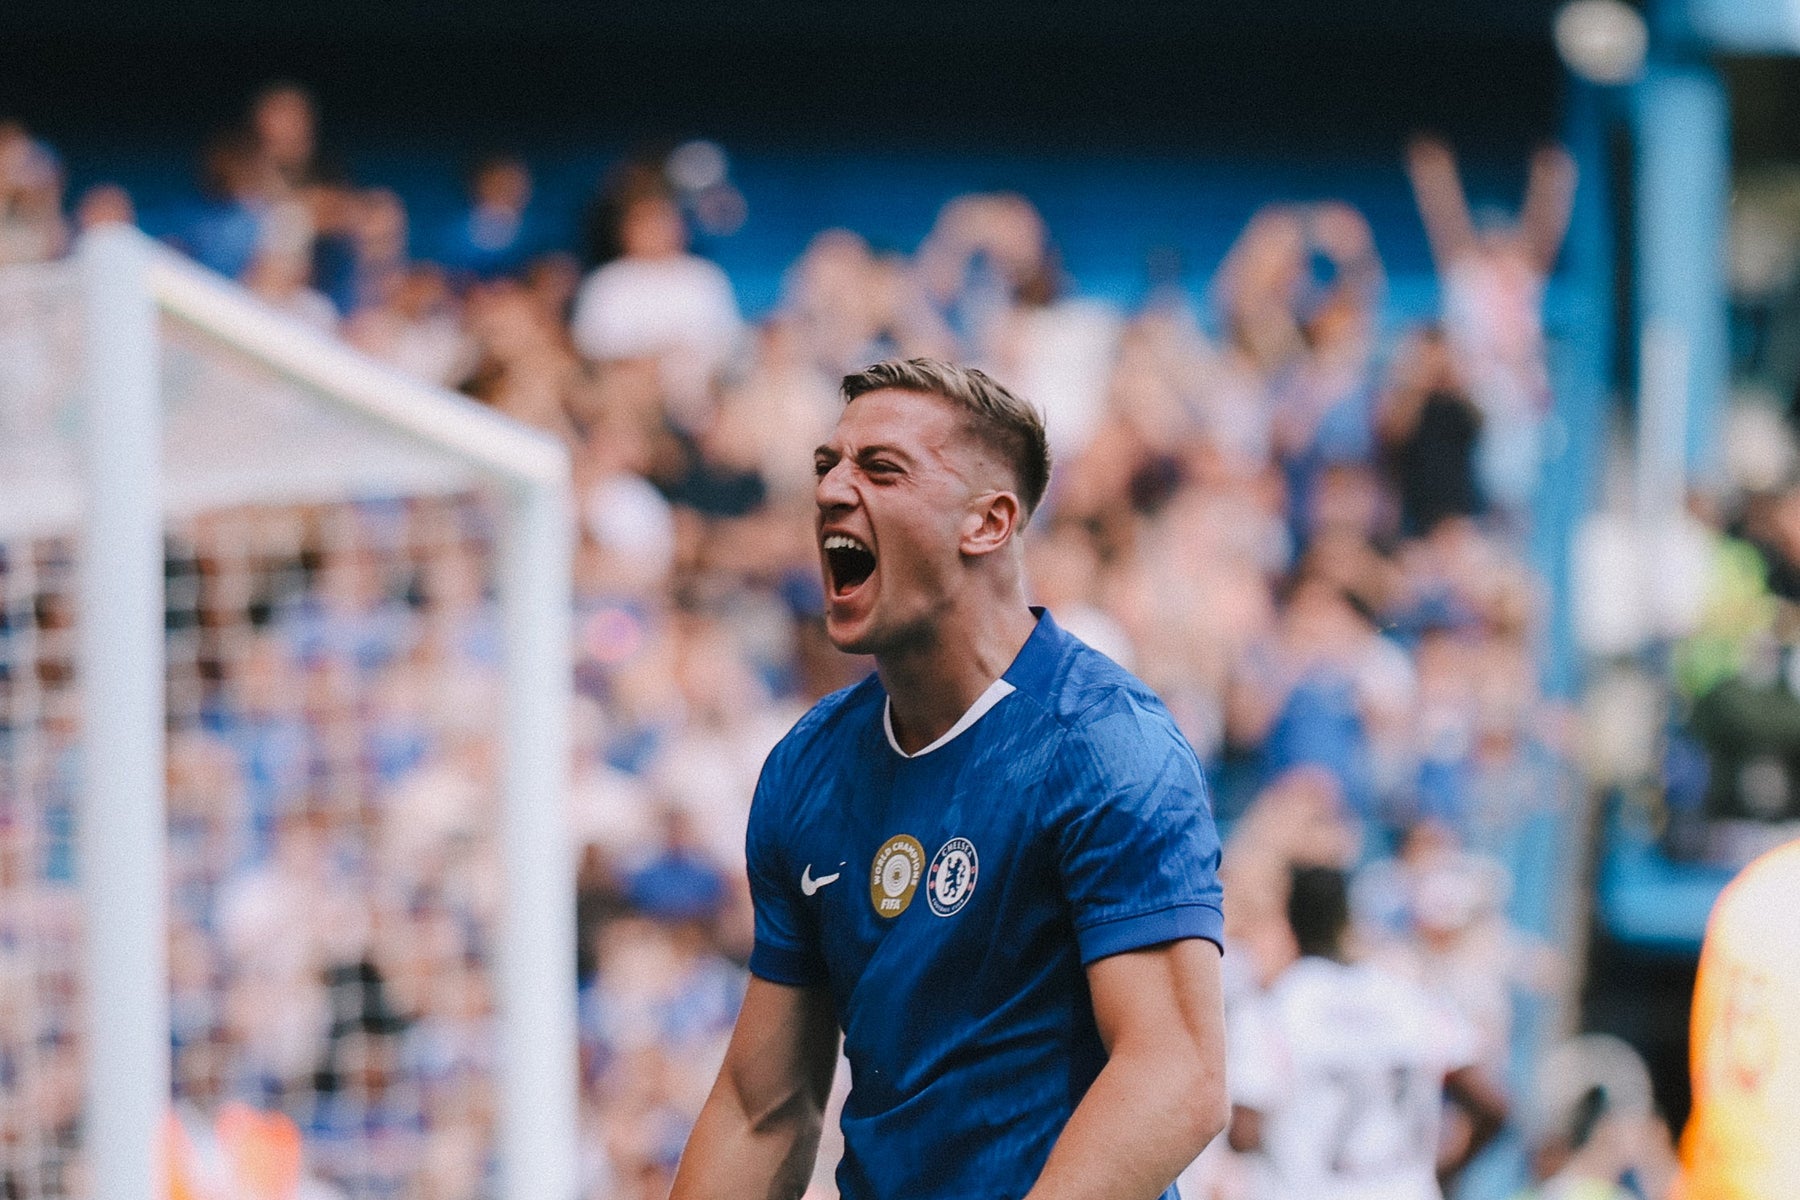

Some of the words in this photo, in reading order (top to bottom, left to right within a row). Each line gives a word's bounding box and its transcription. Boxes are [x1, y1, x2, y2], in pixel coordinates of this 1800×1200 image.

[941, 841, 973, 858] CHELSEA
[874, 847, 892, 885] WORLD
[880, 898, 902, 910] FIFA
